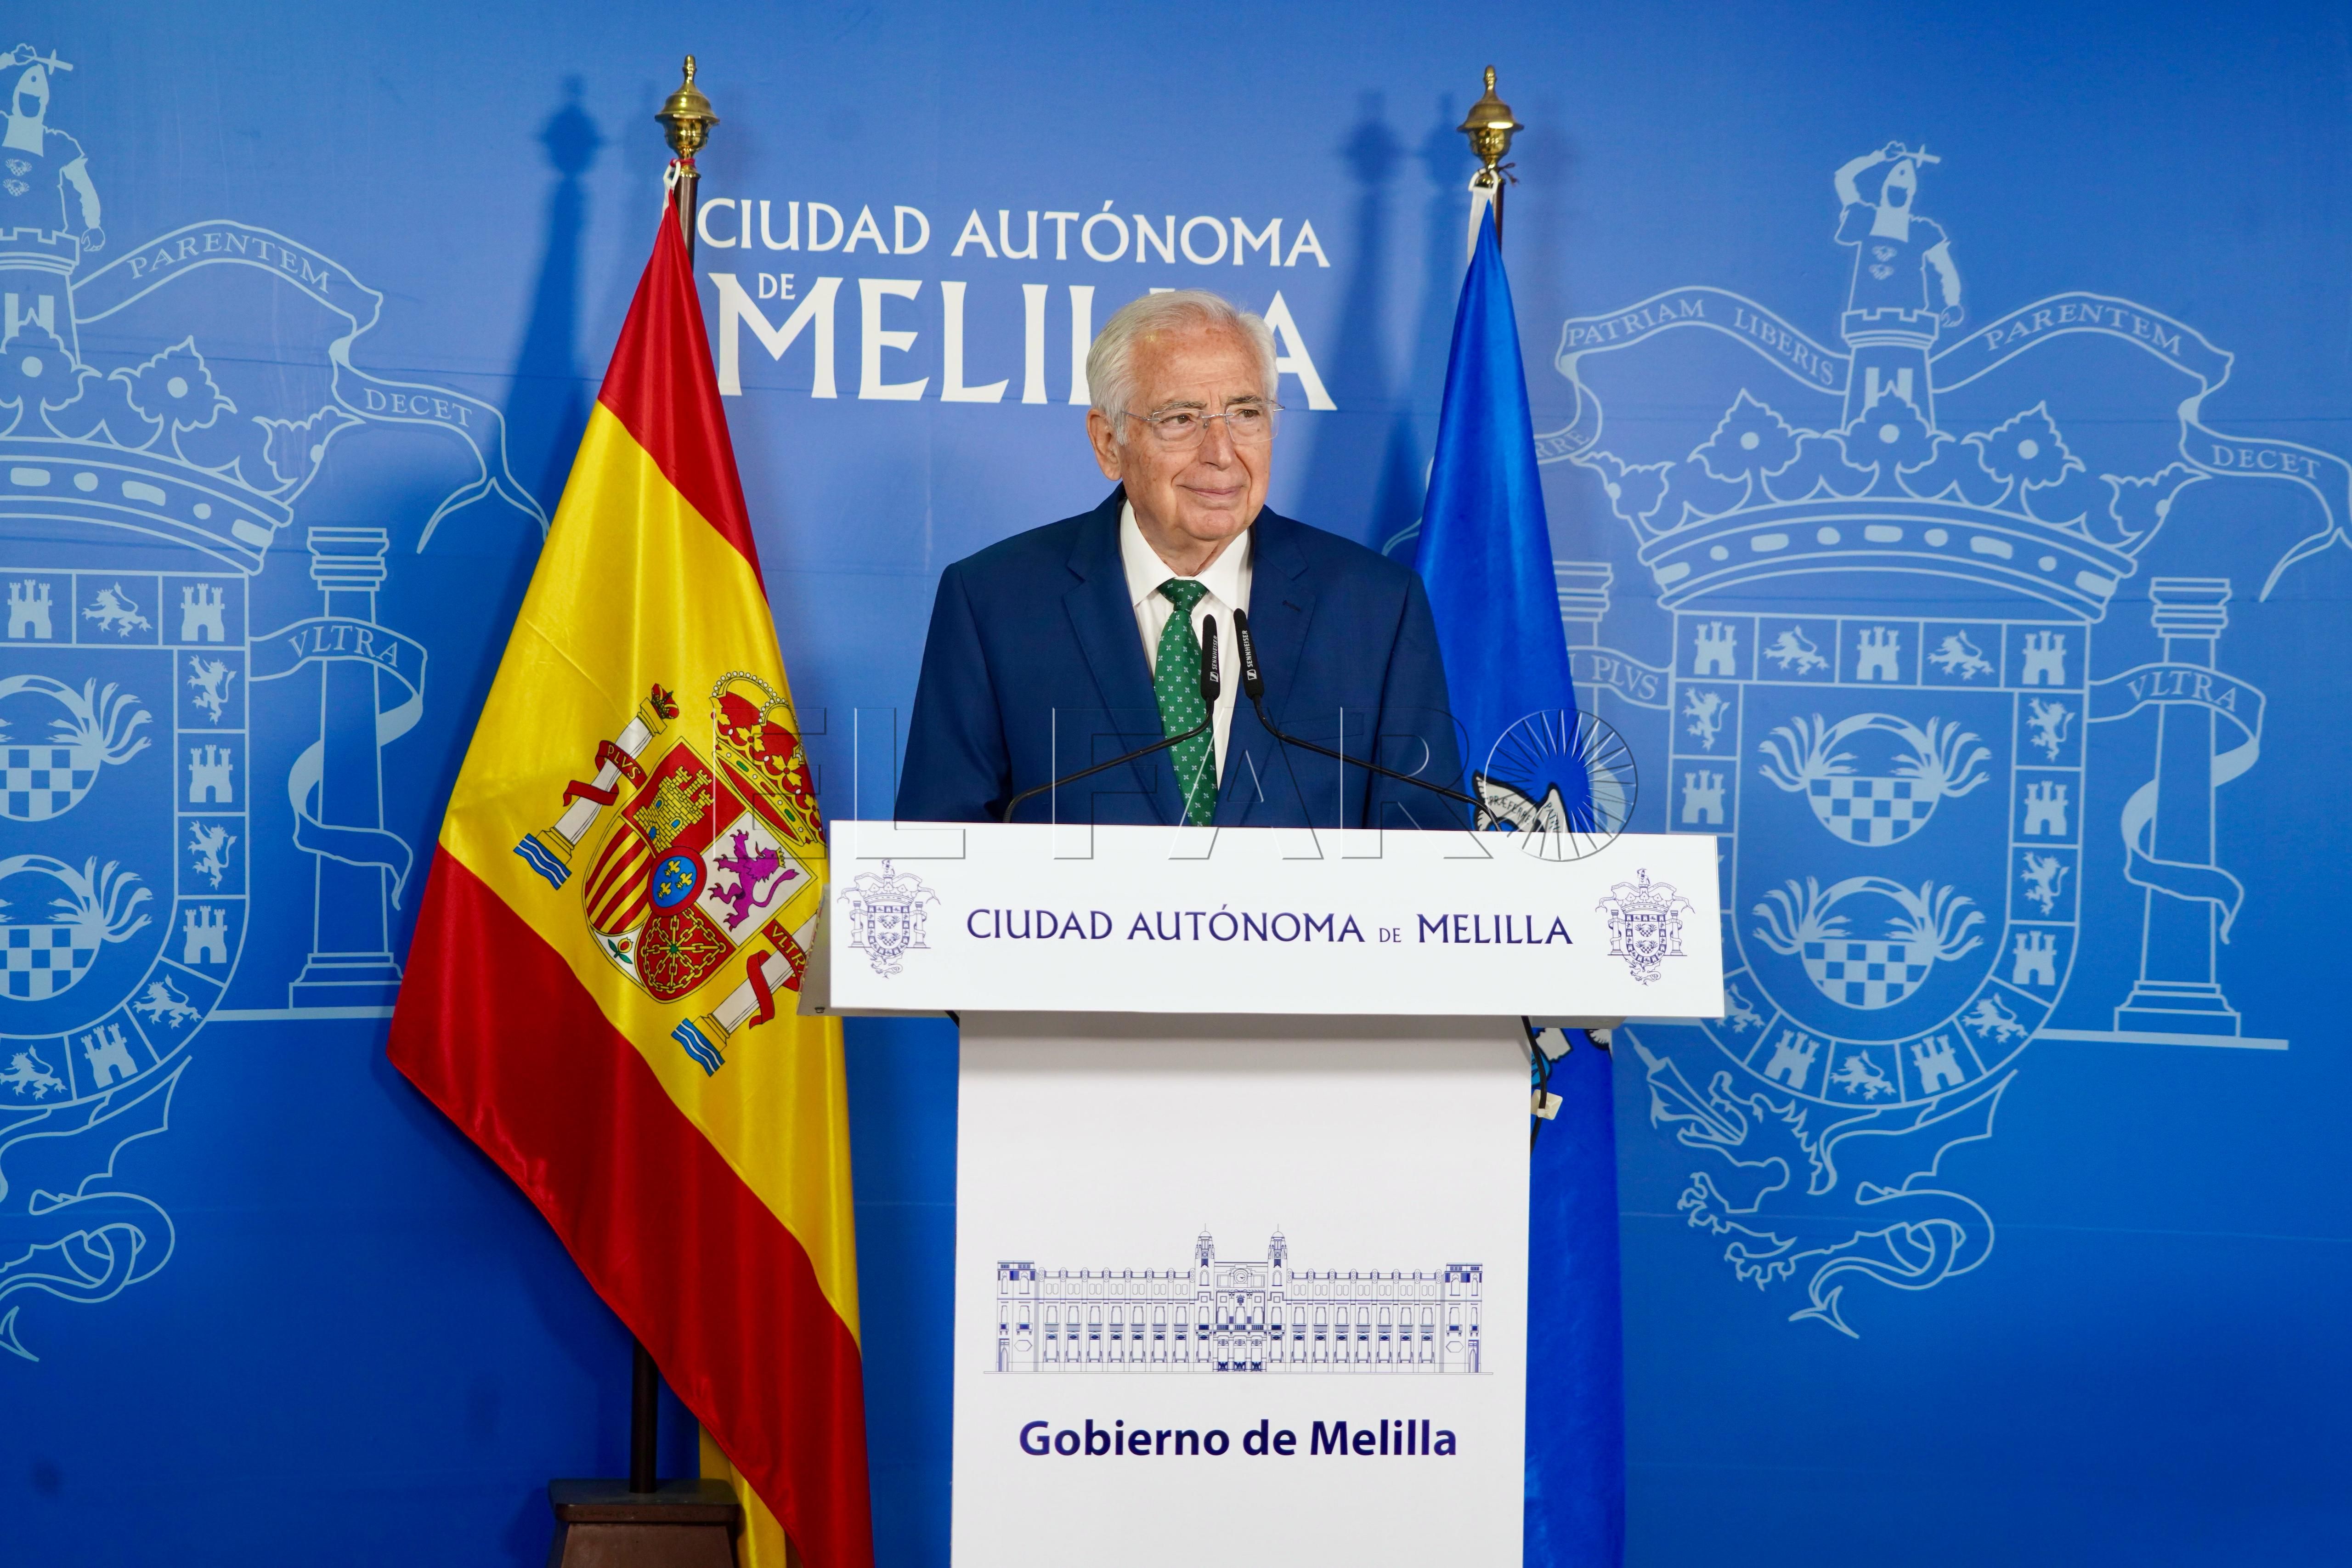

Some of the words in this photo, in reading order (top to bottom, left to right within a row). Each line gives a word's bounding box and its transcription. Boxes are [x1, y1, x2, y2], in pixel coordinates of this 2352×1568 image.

[698, 198, 929, 254] CIUDAD
[951, 201, 1330, 267] AUTÓNOMA
[127, 232, 330, 294] PARENTEM
[759, 273, 795, 299] DE
[708, 272, 1337, 411] MELILA
[1566, 299, 1705, 347] PATRIAM
[1734, 307, 1833, 385] LIBERIS
[1983, 303, 2181, 356] PARENTEM
[363, 388, 473, 427] DECET
[2211, 445, 2320, 479] DECET
[288, 625, 399, 668] VLTRA
[1242, 630, 1254, 667] SENNHEISER
[1591, 654, 1658, 700] PLVS
[2127, 671, 2236, 712] VLTRA
[608, 744, 641, 779] PLVS
[967, 910, 1112, 939] CIUDAD
[1127, 905, 1365, 942] AUTÓNOMA
[1380, 928, 1401, 942] DE
[1418, 914, 1573, 944] MELILLA
[772, 925, 807, 973] VLTR
[1020, 1419, 1229, 1455] Gobierno
[1243, 1419, 1296, 1455] de
[1311, 1419, 1456, 1455] Melilla
